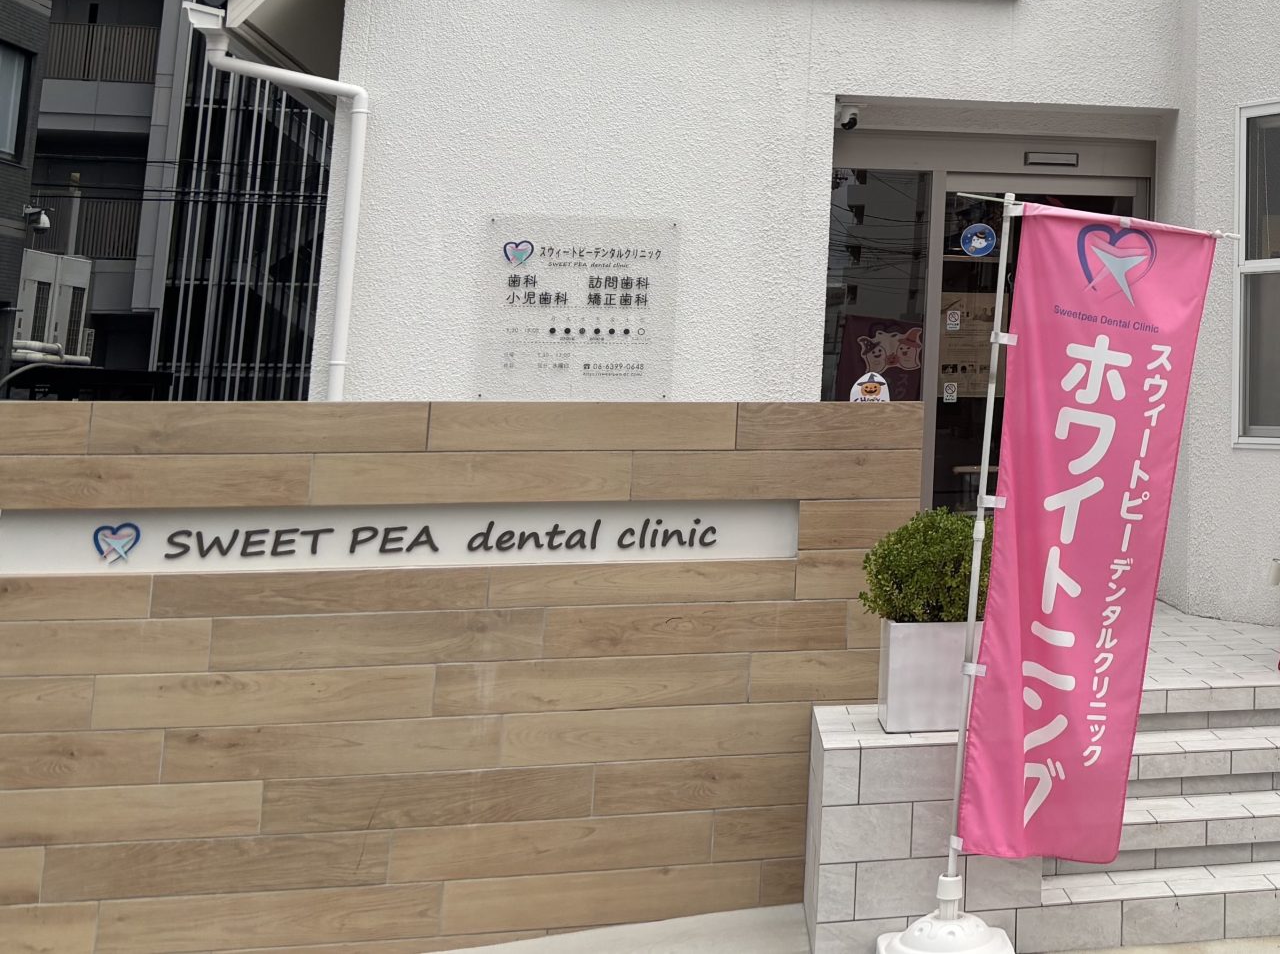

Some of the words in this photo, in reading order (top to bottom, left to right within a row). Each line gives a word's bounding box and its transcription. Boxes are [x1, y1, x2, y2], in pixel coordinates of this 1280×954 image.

[508, 274, 538, 288] 歯科
[589, 276, 650, 290] 訪問歯科
[506, 291, 568, 305] 小児歯科
[587, 293, 648, 306] 矯正歯科
[1054, 305, 1098, 323] Sweetpea
[1100, 315, 1131, 329] Dental
[1133, 321, 1159, 333] Clinic
[592, 363, 645, 371] 06-6399-0648
[164, 528, 334, 559] SWEET
[349, 525, 439, 554] PEA
[467, 519, 601, 552] dental
[617, 518, 717, 549] clinic
[1022, 334, 1133, 829] ホワイトニング
